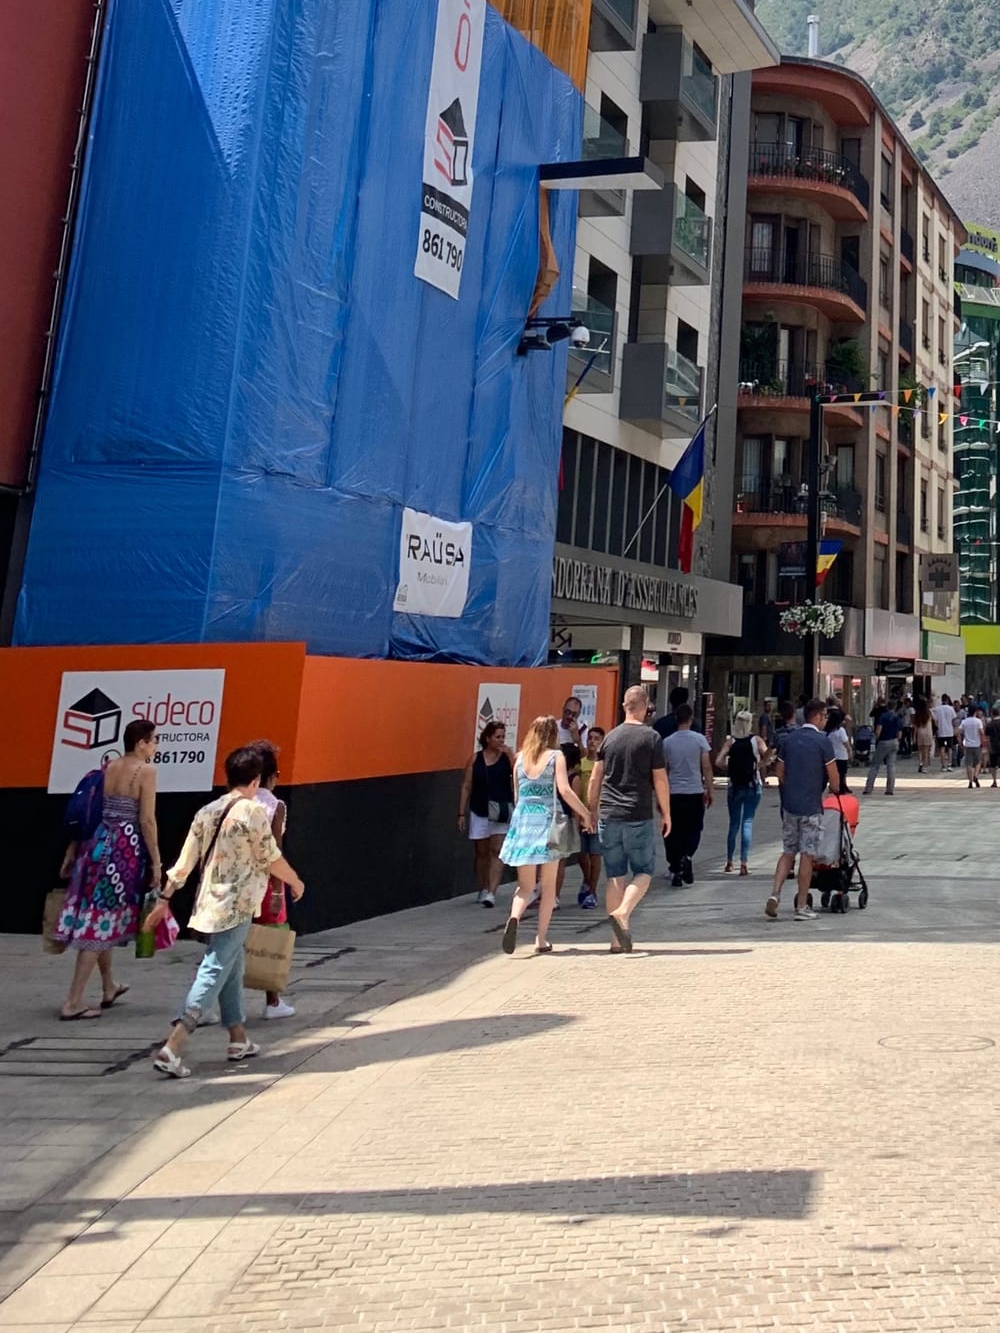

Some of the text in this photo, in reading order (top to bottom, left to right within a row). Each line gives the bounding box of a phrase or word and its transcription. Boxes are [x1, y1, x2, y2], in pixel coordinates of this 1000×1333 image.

[132, 693, 214, 726] sideco
[157, 732, 210, 742] TRUCTORA
[153, 750, 205, 764] 861790
